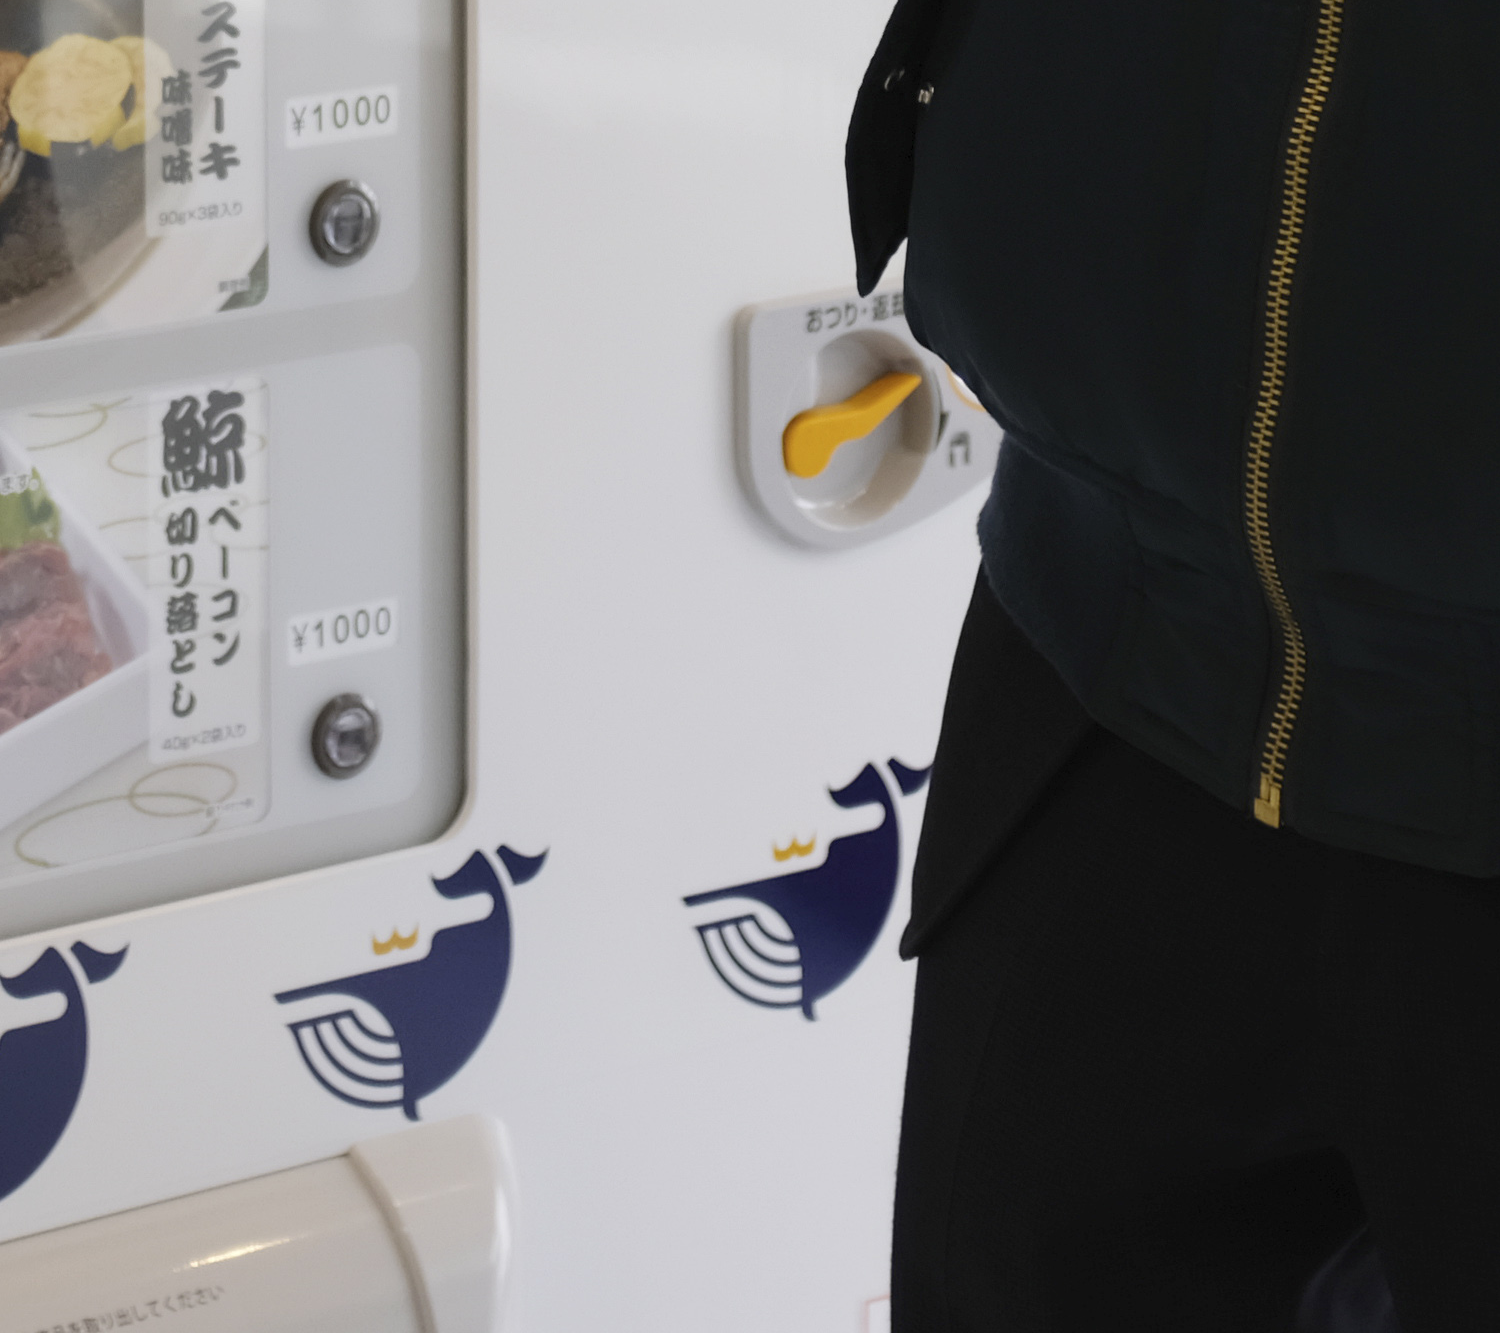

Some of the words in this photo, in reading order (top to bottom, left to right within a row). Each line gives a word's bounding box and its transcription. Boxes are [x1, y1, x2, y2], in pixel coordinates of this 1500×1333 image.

[291, 93, 392, 137] ¥1000
[161, 389, 245, 498] 鯨
[208, 499, 242, 667] ベーコン
[291, 606, 392, 653] ¥1000
